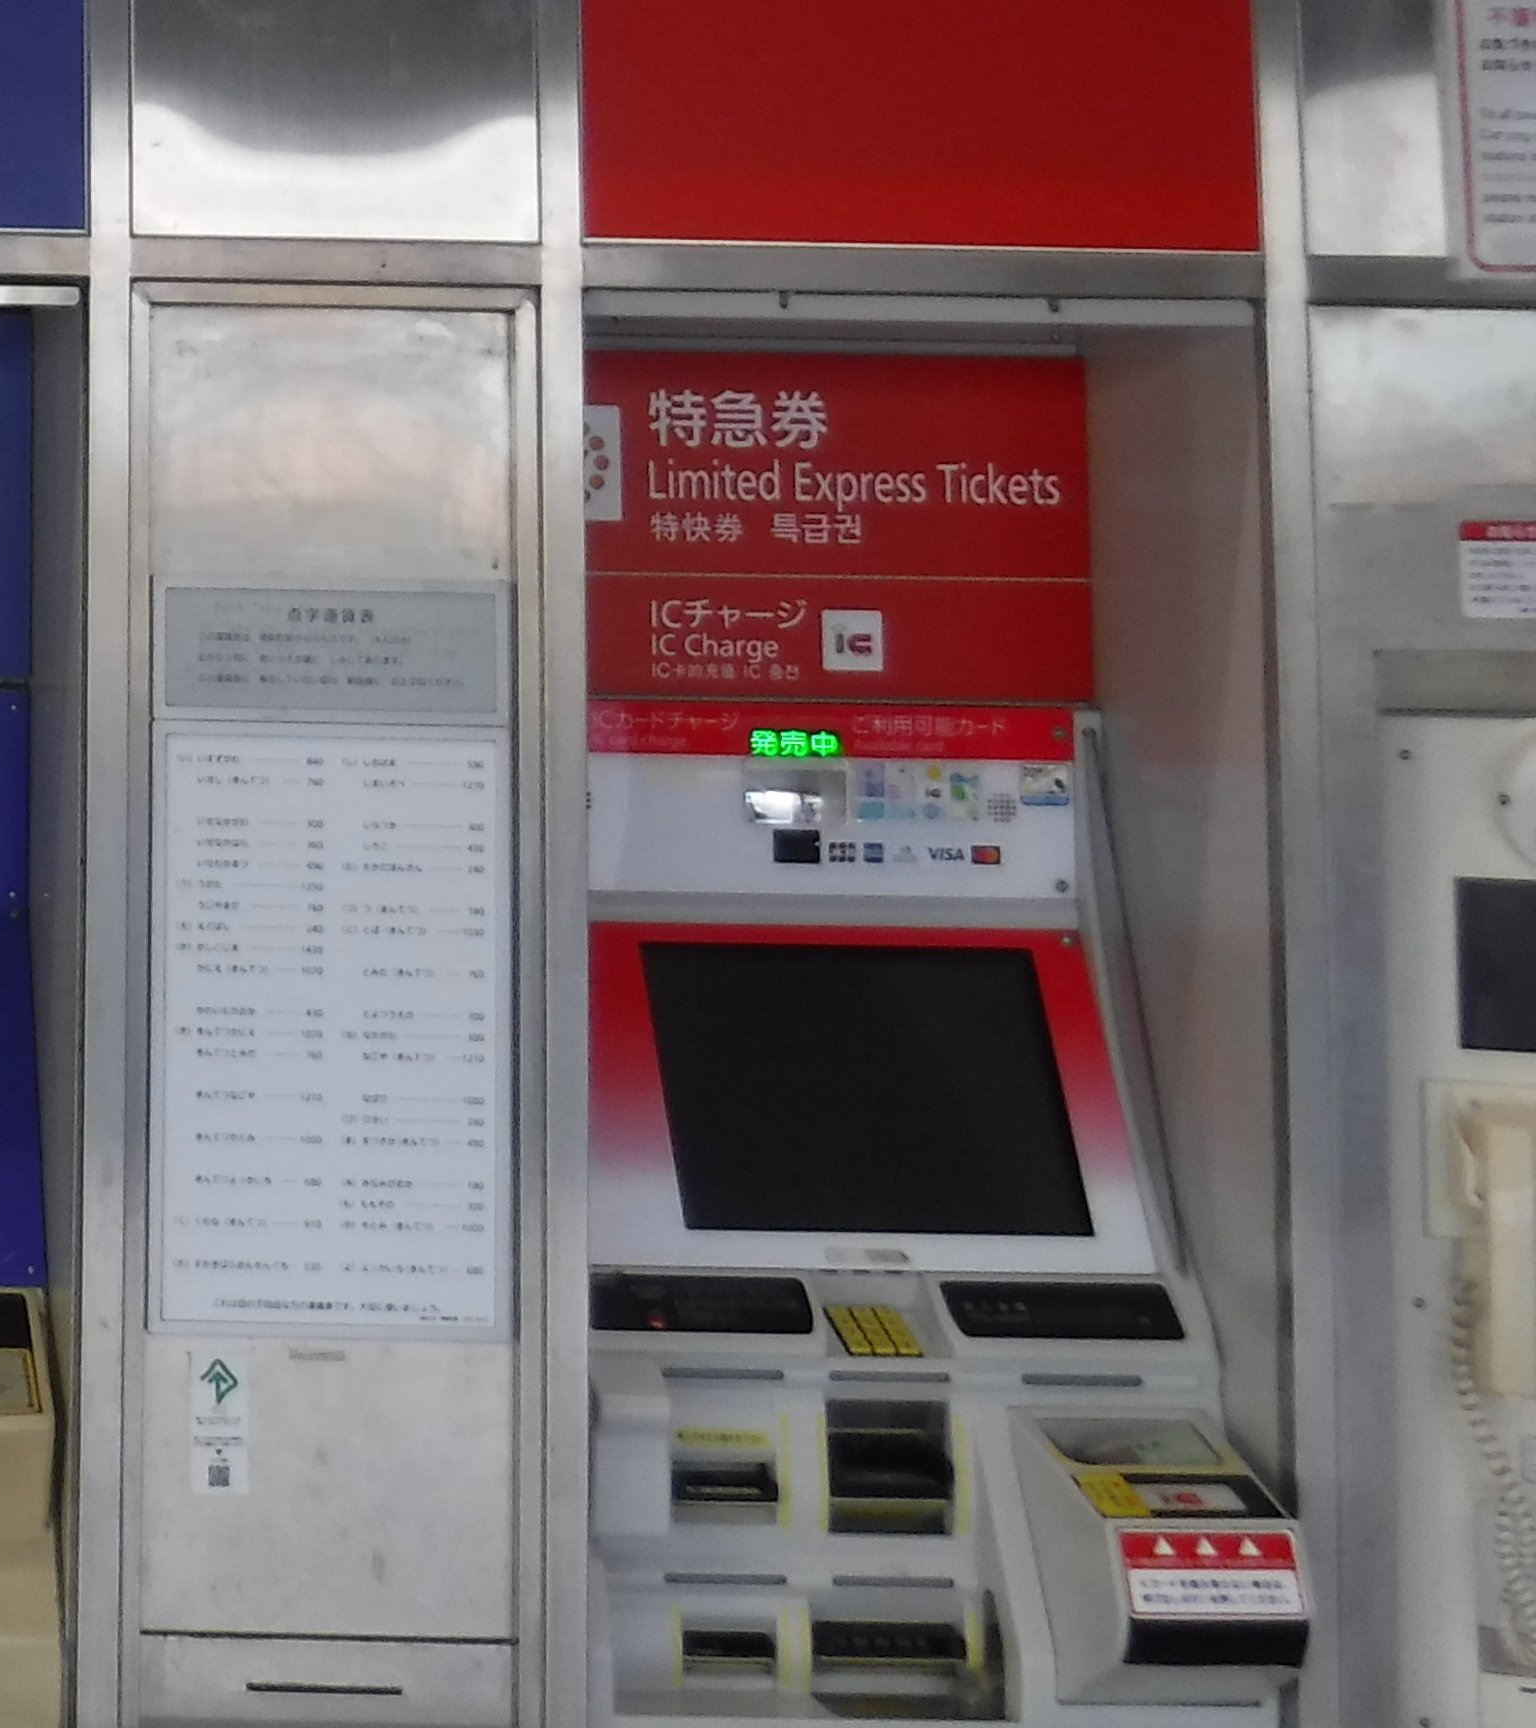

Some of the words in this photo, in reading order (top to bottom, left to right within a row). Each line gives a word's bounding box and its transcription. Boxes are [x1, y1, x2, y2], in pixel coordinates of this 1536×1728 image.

[648, 389, 828, 448] 特急券
[649, 459, 781, 503] Limited
[794, 463, 927, 510] Express
[936, 464, 1062, 506] Tickets
[650, 513, 742, 542] 特快券
[771, 514, 863, 544] 특급권
[650, 599, 807, 630] ICチャージ
[651, 634, 675, 656] IC
[684, 634, 779, 664] Charge
[750, 730, 839, 757] 発売中
[929, 847, 964, 862] VISA
